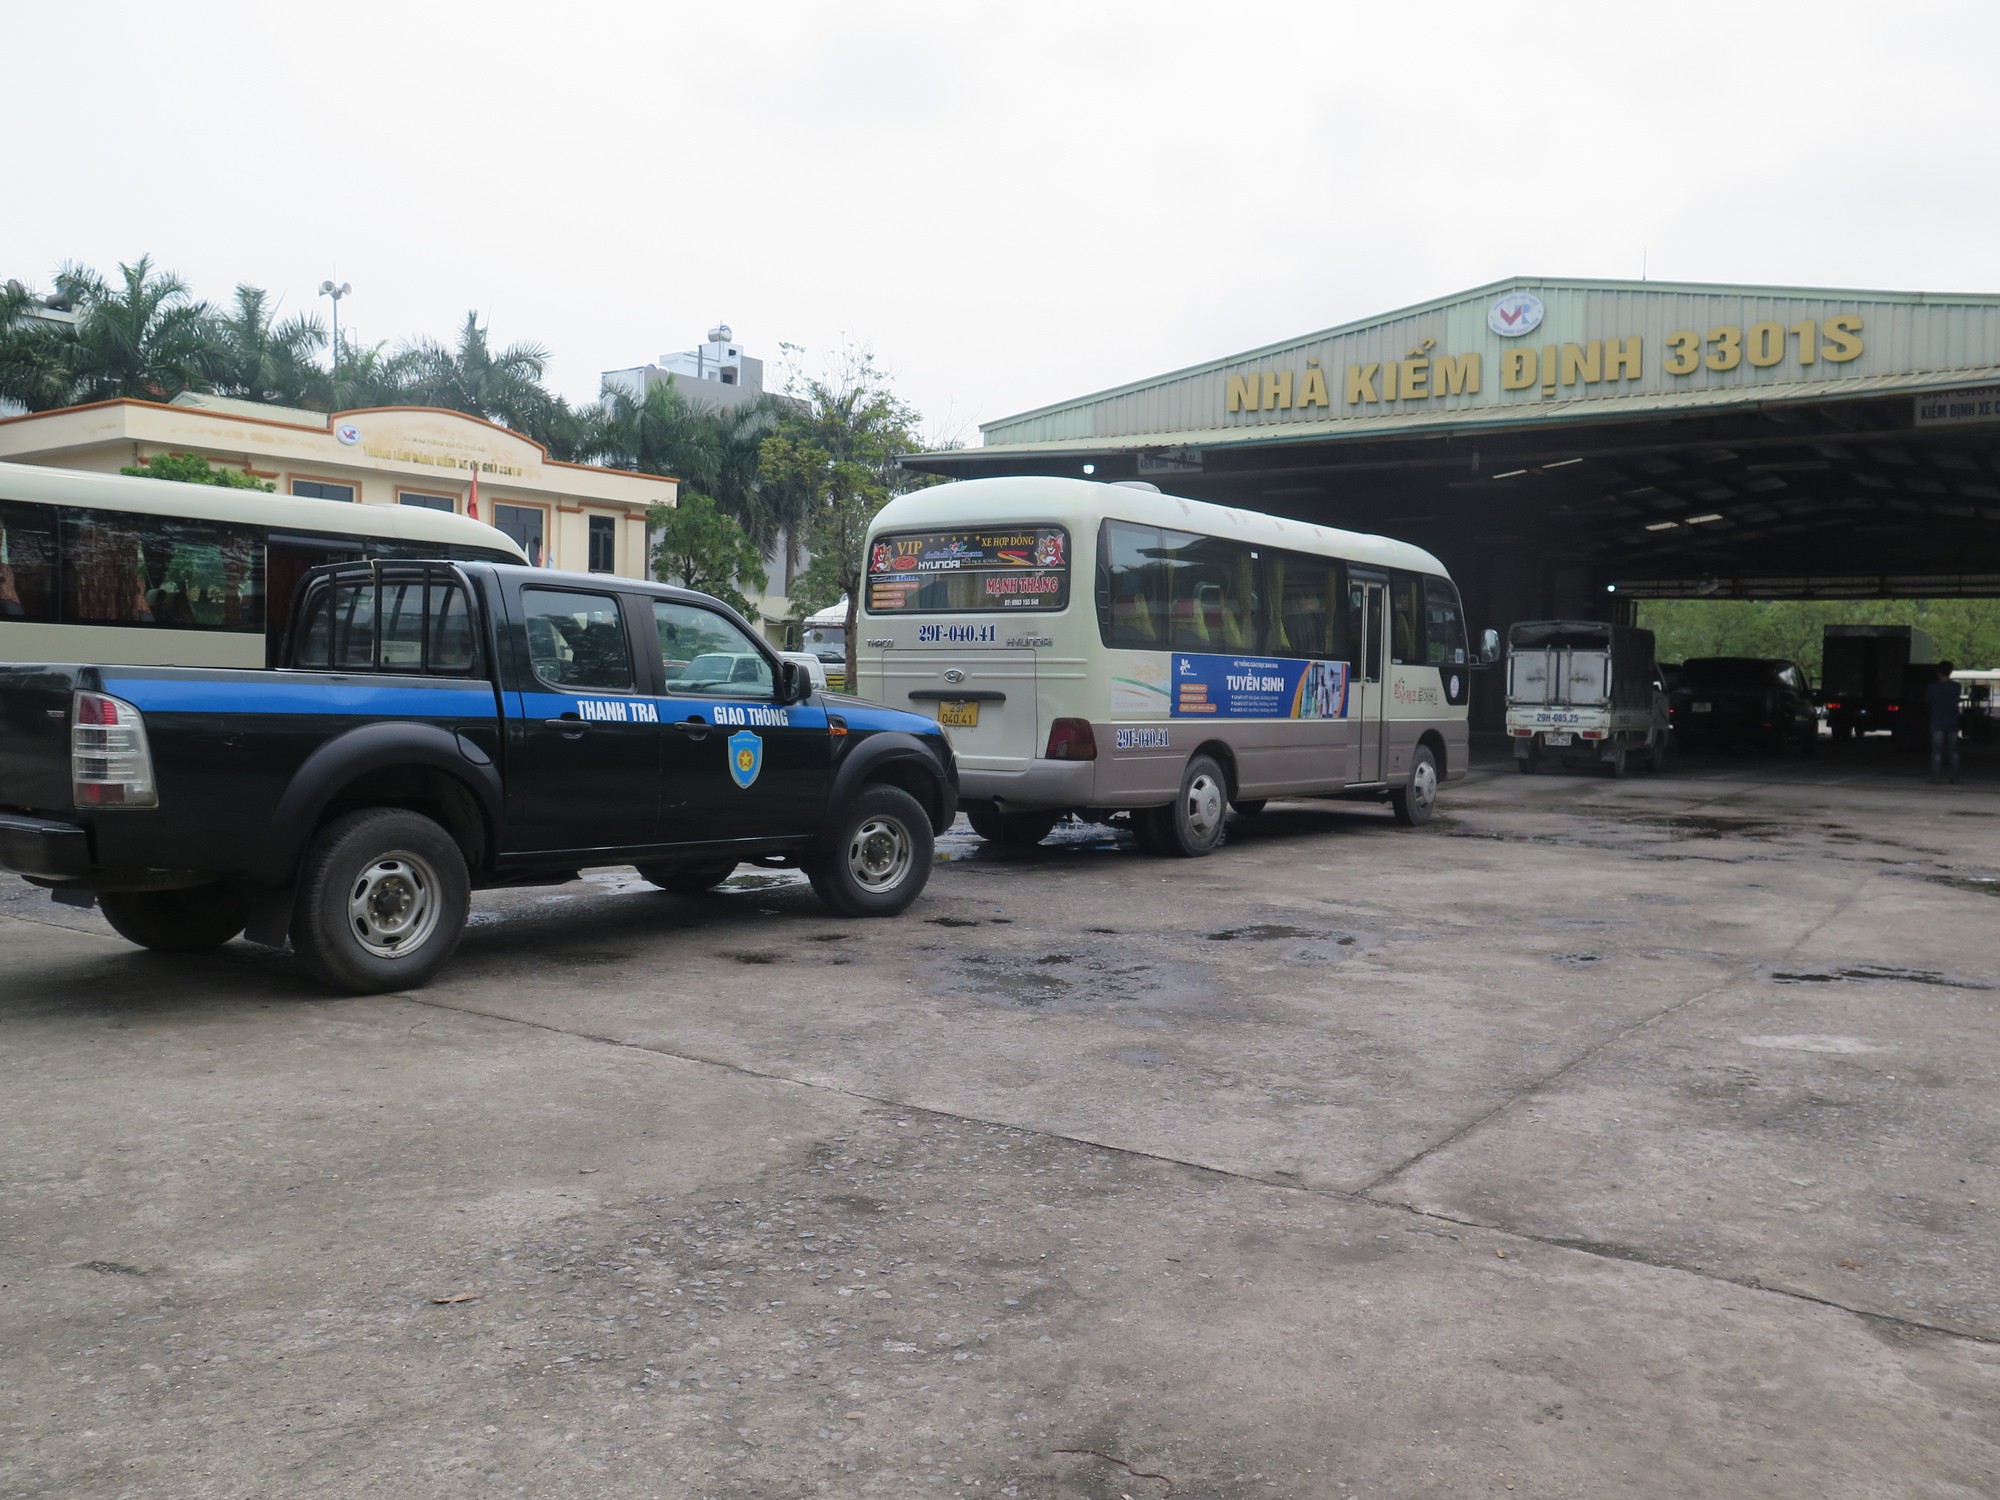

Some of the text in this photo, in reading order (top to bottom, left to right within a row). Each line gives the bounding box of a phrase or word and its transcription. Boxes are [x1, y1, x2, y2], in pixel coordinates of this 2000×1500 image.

[1228, 314, 1865, 412] NHÀ KIỂM ĐỊNH 3301S
[1979, 401, 1991, 415] XE
[896, 540, 923, 556] VIP
[981, 532, 1035, 548] XE HỢP ĐỒNG
[918, 560, 961, 570] HYUNDAI
[986, 571, 1059, 598] MẠNH THẮNG
[919, 624, 996, 643] 29F-040.41
[1006, 636, 1053, 647] HYUNDAI
[1261, 677, 1285, 692] SINH
[577, 700, 659, 723] THANH TRA
[713, 705, 789, 727] GIAO THÔNG
[942, 713, 972, 724] 040.41
[1116, 728, 1170, 749] 29F-040.41
